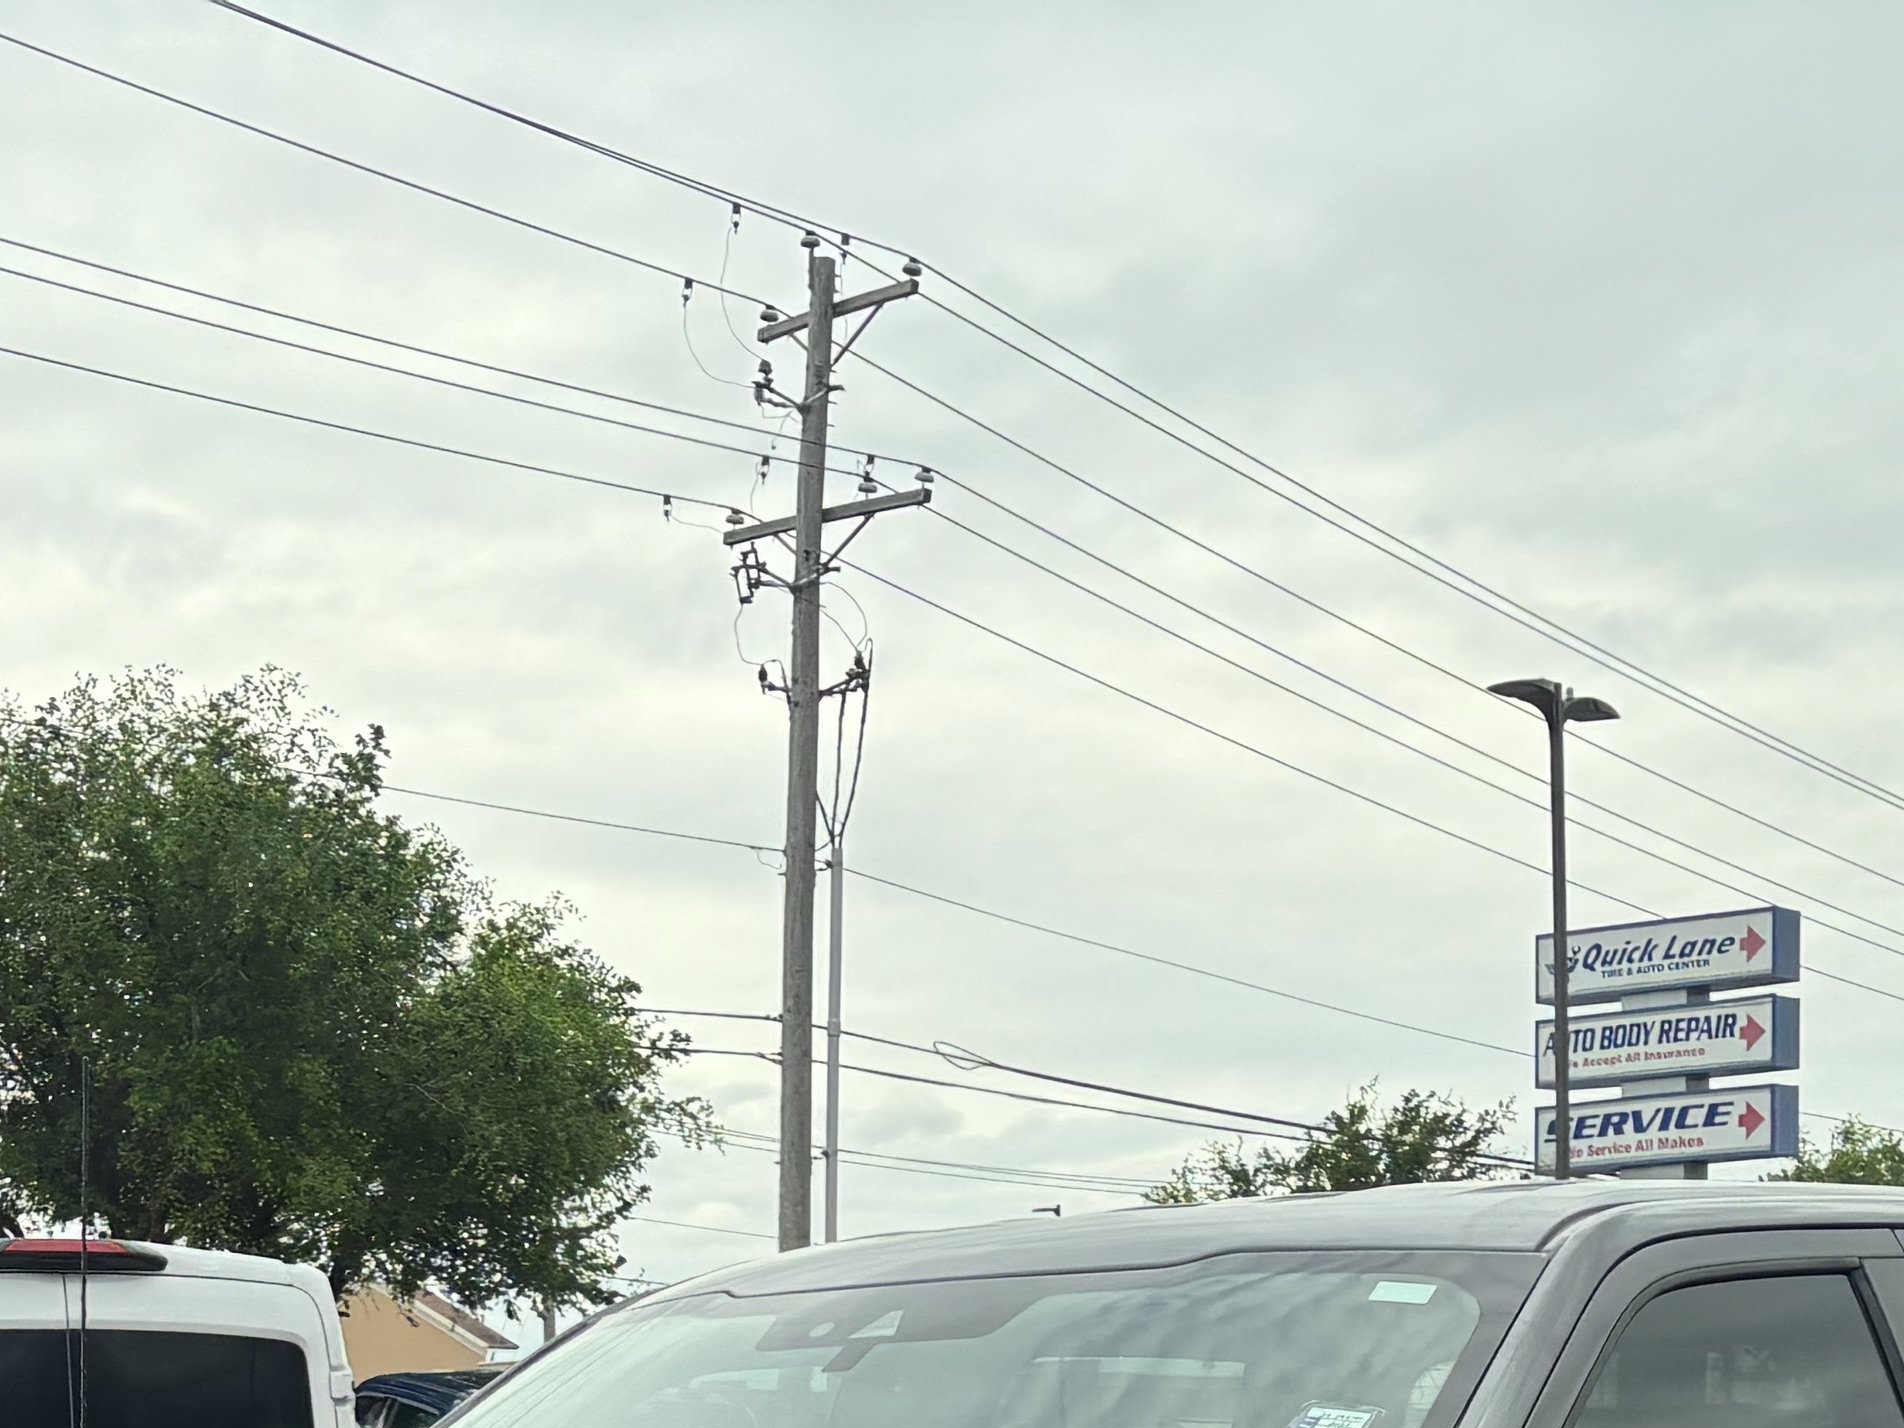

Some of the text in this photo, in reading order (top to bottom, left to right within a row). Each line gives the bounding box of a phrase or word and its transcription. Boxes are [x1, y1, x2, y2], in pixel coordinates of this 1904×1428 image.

[1582, 935, 1736, 972] Quick Lane
[1601, 969, 1623, 978] TIRE
[1636, 963, 1664, 974] AUTO
[1668, 959, 1710, 972] CENTER
[1543, 1013, 1738, 1057] ATO BODY REPAIR
[1582, 1054, 1623, 1067] Accept
[1645, 1047, 1706, 1060] Insurance
[1587, 1144, 1632, 1158] Service
[1635, 1139, 1654, 1152] All
[1657, 1136, 1705, 1149] Makes
